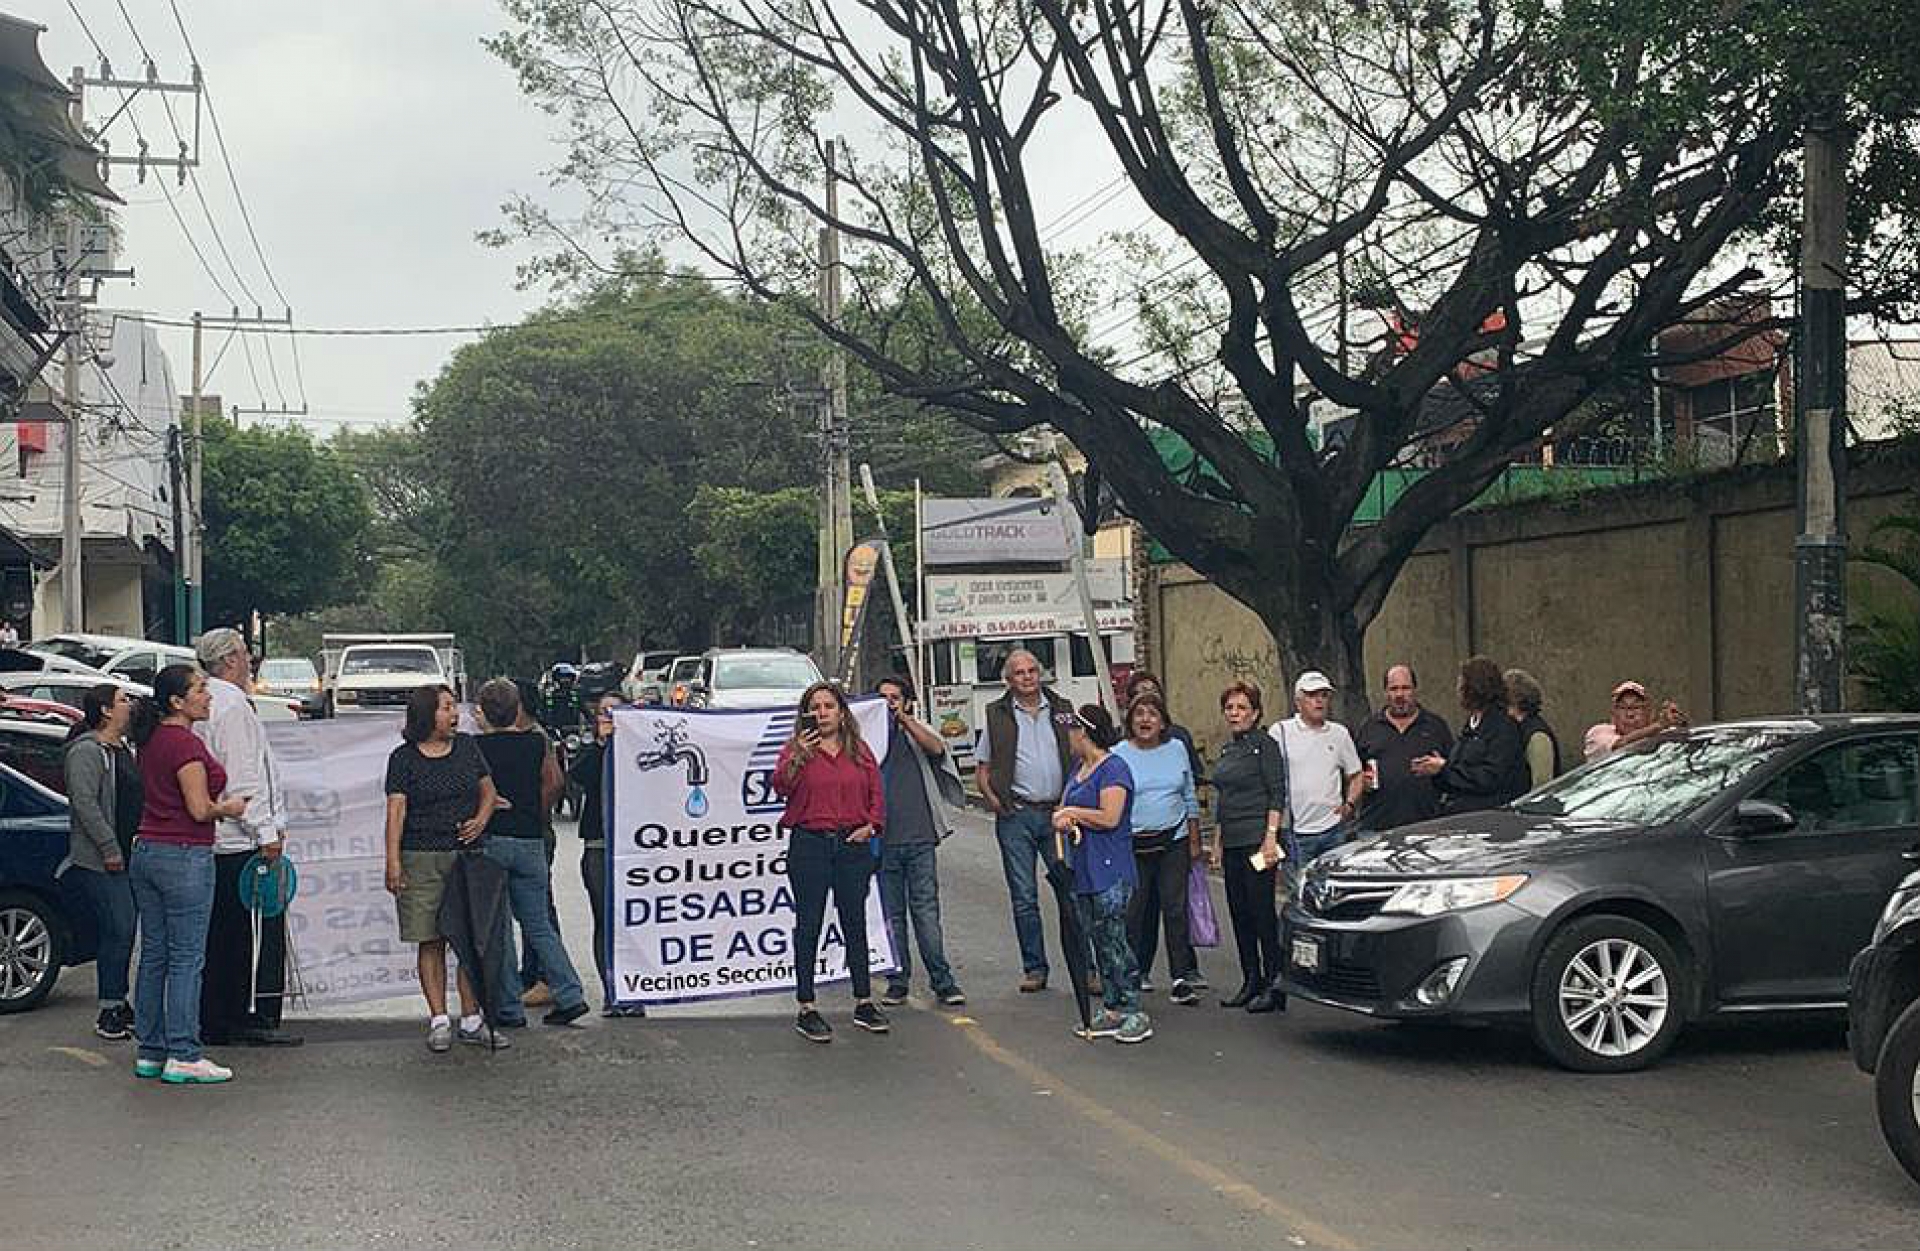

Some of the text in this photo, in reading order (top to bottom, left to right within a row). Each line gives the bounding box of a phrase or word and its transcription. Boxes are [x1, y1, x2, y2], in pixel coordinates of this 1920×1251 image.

[626, 850, 789, 887] solució
[624, 886, 796, 927] DESABA
[660, 922, 846, 966] DE AGA
[624, 971, 711, 993] Vecinos
